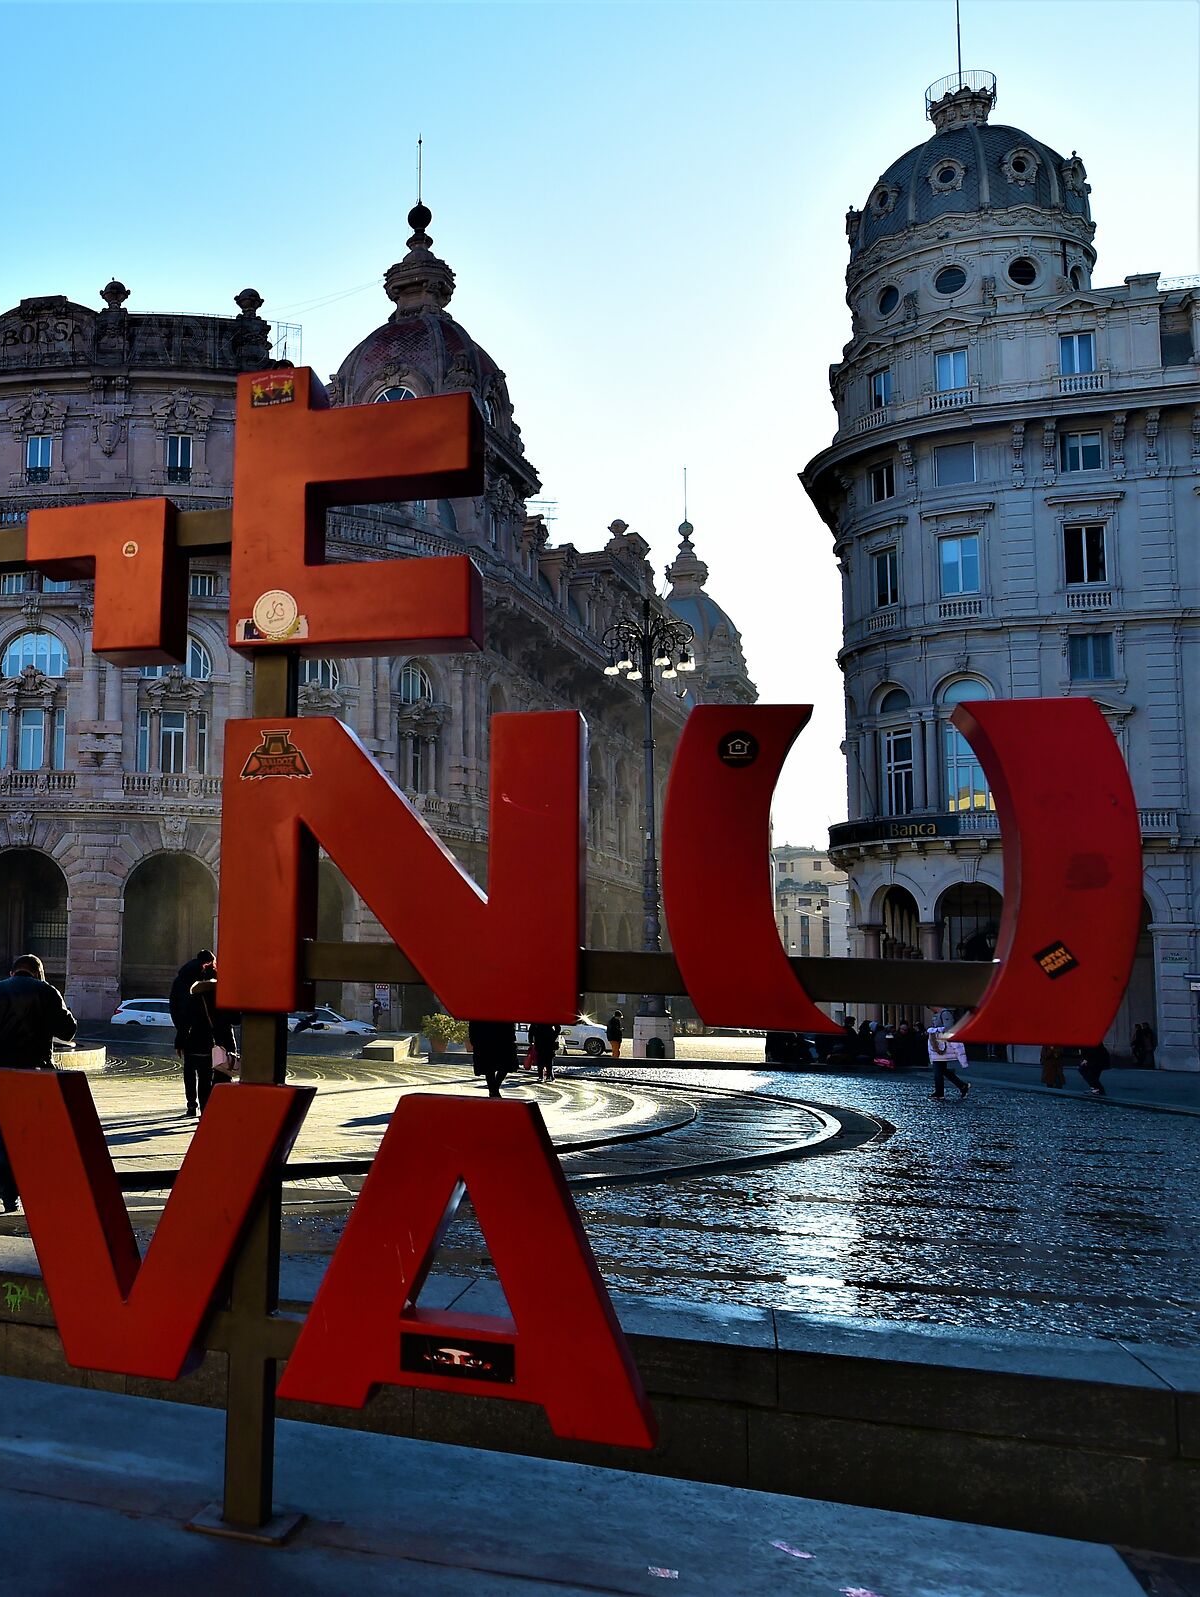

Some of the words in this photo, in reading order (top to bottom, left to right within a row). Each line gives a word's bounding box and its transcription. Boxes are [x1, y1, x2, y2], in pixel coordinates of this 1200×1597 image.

[0, 321, 85, 347] BORSA
[889, 822, 937, 837] Banca
[215, 698, 1136, 1046] NO
